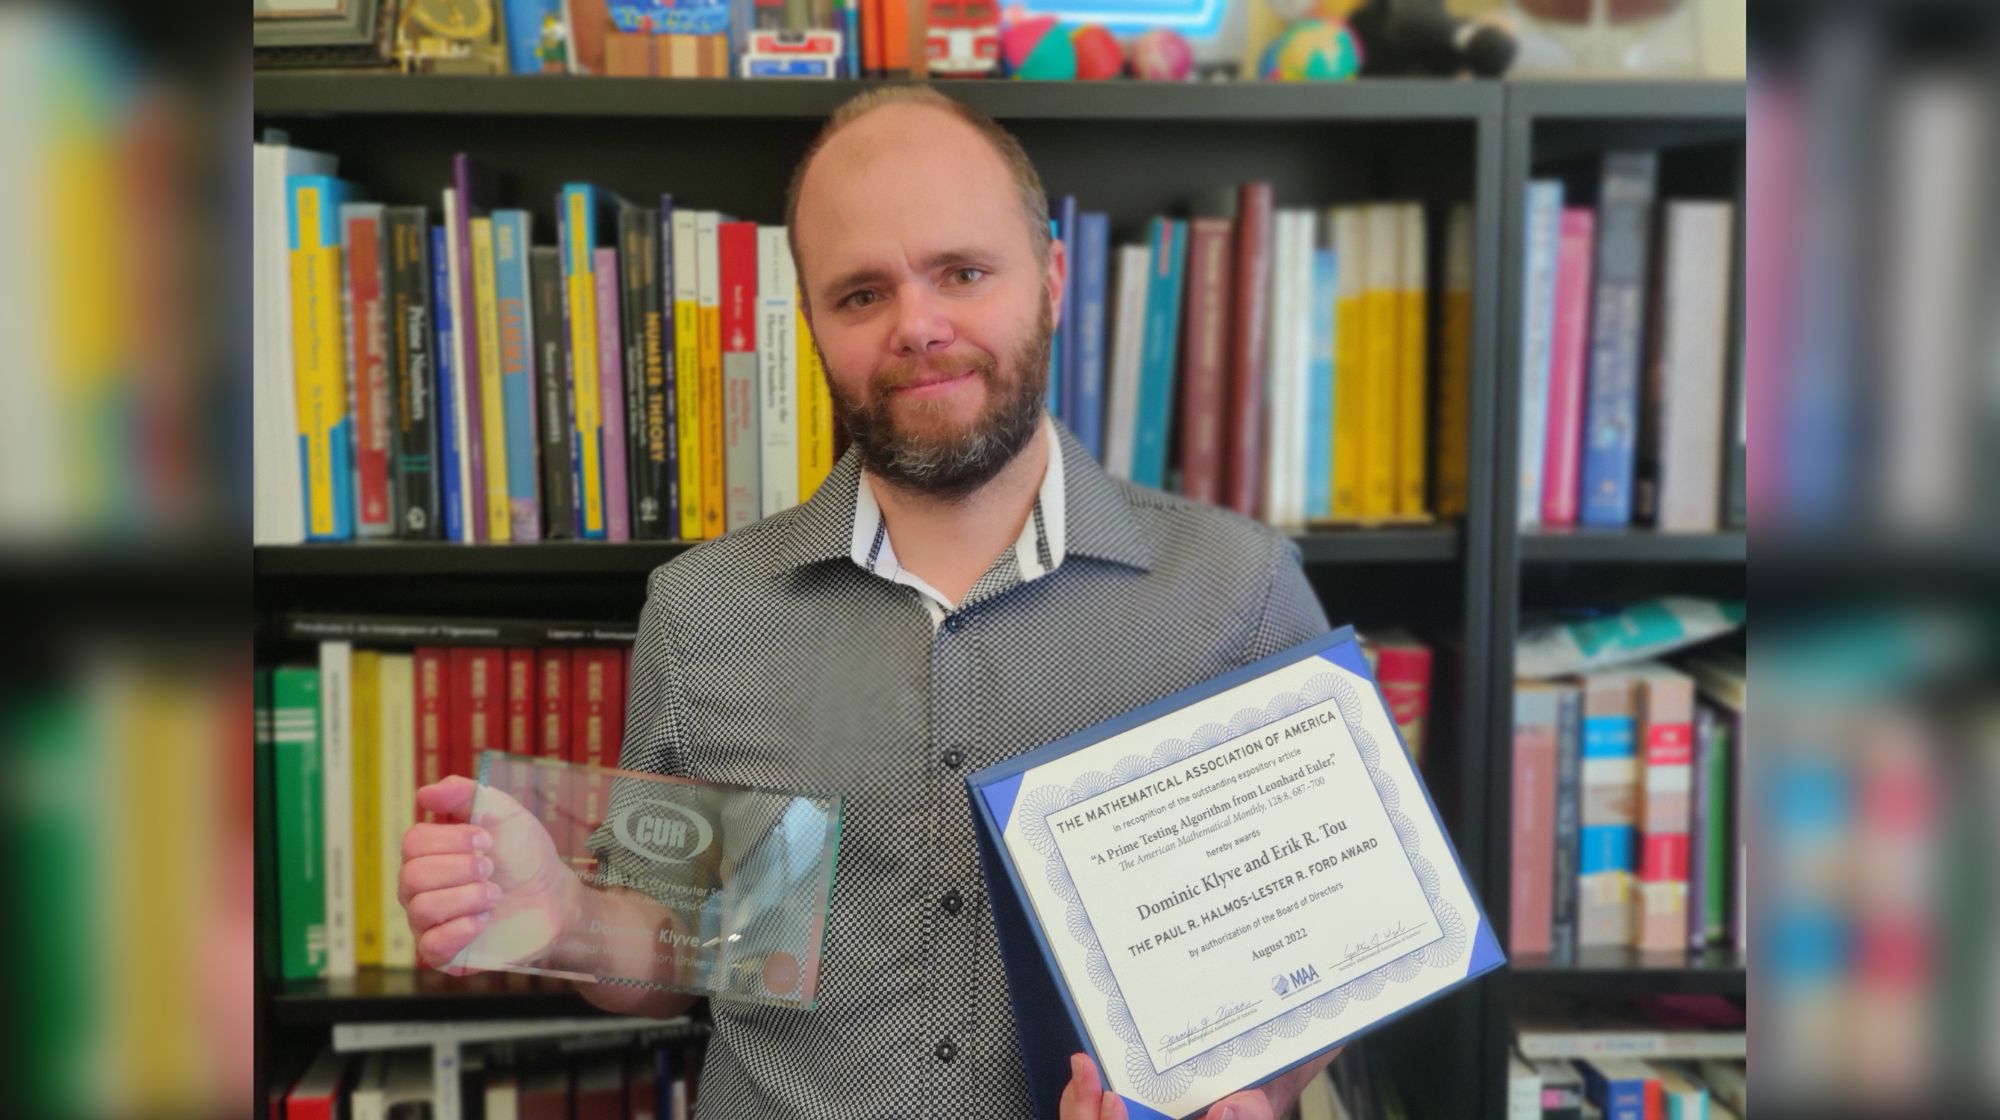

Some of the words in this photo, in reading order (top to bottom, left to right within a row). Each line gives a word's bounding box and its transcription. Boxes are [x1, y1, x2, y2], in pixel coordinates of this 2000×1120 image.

[408, 306, 425, 350] Prime
[499, 299, 527, 374] GAMMA
[644, 312, 664, 386] NUMBER
[410, 353, 428, 420] Numbers
[648, 393, 666, 463] THEORY
[1056, 815, 1084, 833] THE
[1085, 776, 1183, 822] MATHEMATICAL
[1186, 740, 1263, 781] ASSOCIATION
[1265, 732, 1279, 746] OF
[1285, 711, 1336, 739] AMERICA
[1123, 806, 1166, 828] recognition
[1168, 800, 1176, 809] of
[1177, 796, 1190, 805] the
[1192, 776, 1237, 799] outstanding
[1238, 760, 1276, 780] expository
[1278, 749, 1301, 763] article
[636, 815, 688, 848] CUR
[1106, 841, 1139, 860] Prime
[1139, 825, 1179, 845] Testing
[1181, 802, 1231, 829] Algorithm
[1232, 791, 1258, 806] from
[1258, 767, 1305, 795] Leonhard
[1119, 860, 1135, 871] The
[1138, 842, 1176, 864] American
[1177, 815, 1231, 847] Mathematical
[1233, 803, 1267, 823] Monthly,
[1206, 842, 1232, 858] hereby
[1234, 830, 1260, 845] awards
[1128, 939, 1153, 956] THE
[1155, 925, 1186, 945] PAUL
[1187, 920, 1200, 930] R.
[1201, 875, 1294, 924] HALMOS-LESTER
[1295, 871, 1308, 882] R.
[1308, 856, 1337, 876] FORD
[1341, 838, 1377, 861] AWARD
[1136, 885, 1201, 920] Dominic
[1201, 867, 1242, 892] Klyve
[1244, 850, 1271, 873] and
[1270, 838, 1303, 860] Erik
[1302, 832, 1319, 846] R.
[1319, 821, 1347, 838] Tou
[658, 927, 702, 949] Klyve
[1189, 948, 1199, 957] by
[1201, 925, 1252, 952] authorization
[1253, 918, 1260, 928] of
[1262, 914, 1276, 924] the
[1276, 901, 1299, 917] Board
[1300, 896, 1308, 906] of
[1309, 882, 1343, 902] Directors
[1252, 940, 1284, 961] August
[1284, 928, 1307, 945] 2022
[1289, 964, 1319, 988] MAA
